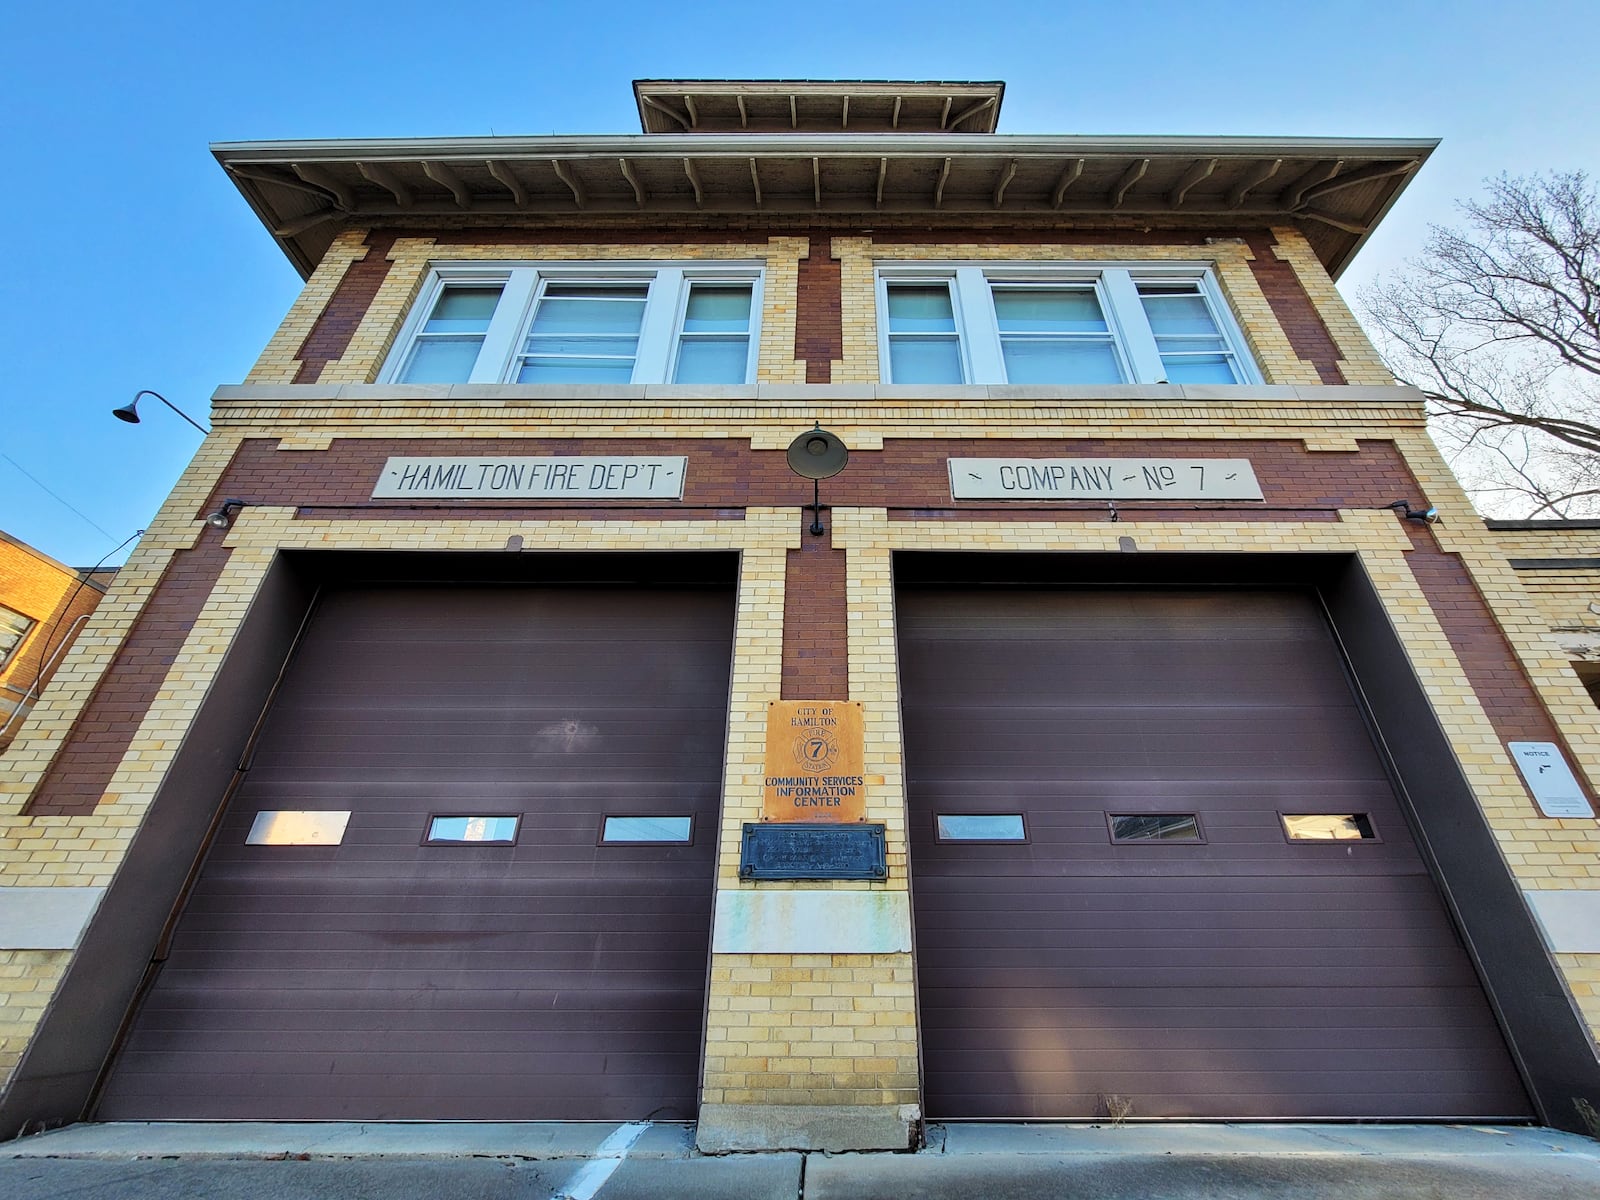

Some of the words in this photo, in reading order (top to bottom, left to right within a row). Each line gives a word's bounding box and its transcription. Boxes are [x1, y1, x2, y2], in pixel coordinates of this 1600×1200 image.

[397, 464, 524, 491] HAMILTON
[528, 464, 583, 491] FIRE
[588, 463, 663, 491] DEP'T
[999, 465, 1113, 491] COMPANY
[1190, 466, 1204, 491] 7
[797, 707, 816, 715] CITY
[822, 707, 833, 715] OF
[791, 717, 837, 726] HAMILTON
[808, 729, 825, 737] FIRE
[810, 741, 823, 758] 7
[765, 776, 819, 787] COMMUNITY
[822, 776, 863, 786] SERVICES
[776, 786, 855, 796] INFORMATION
[794, 797, 841, 807] CENTER
